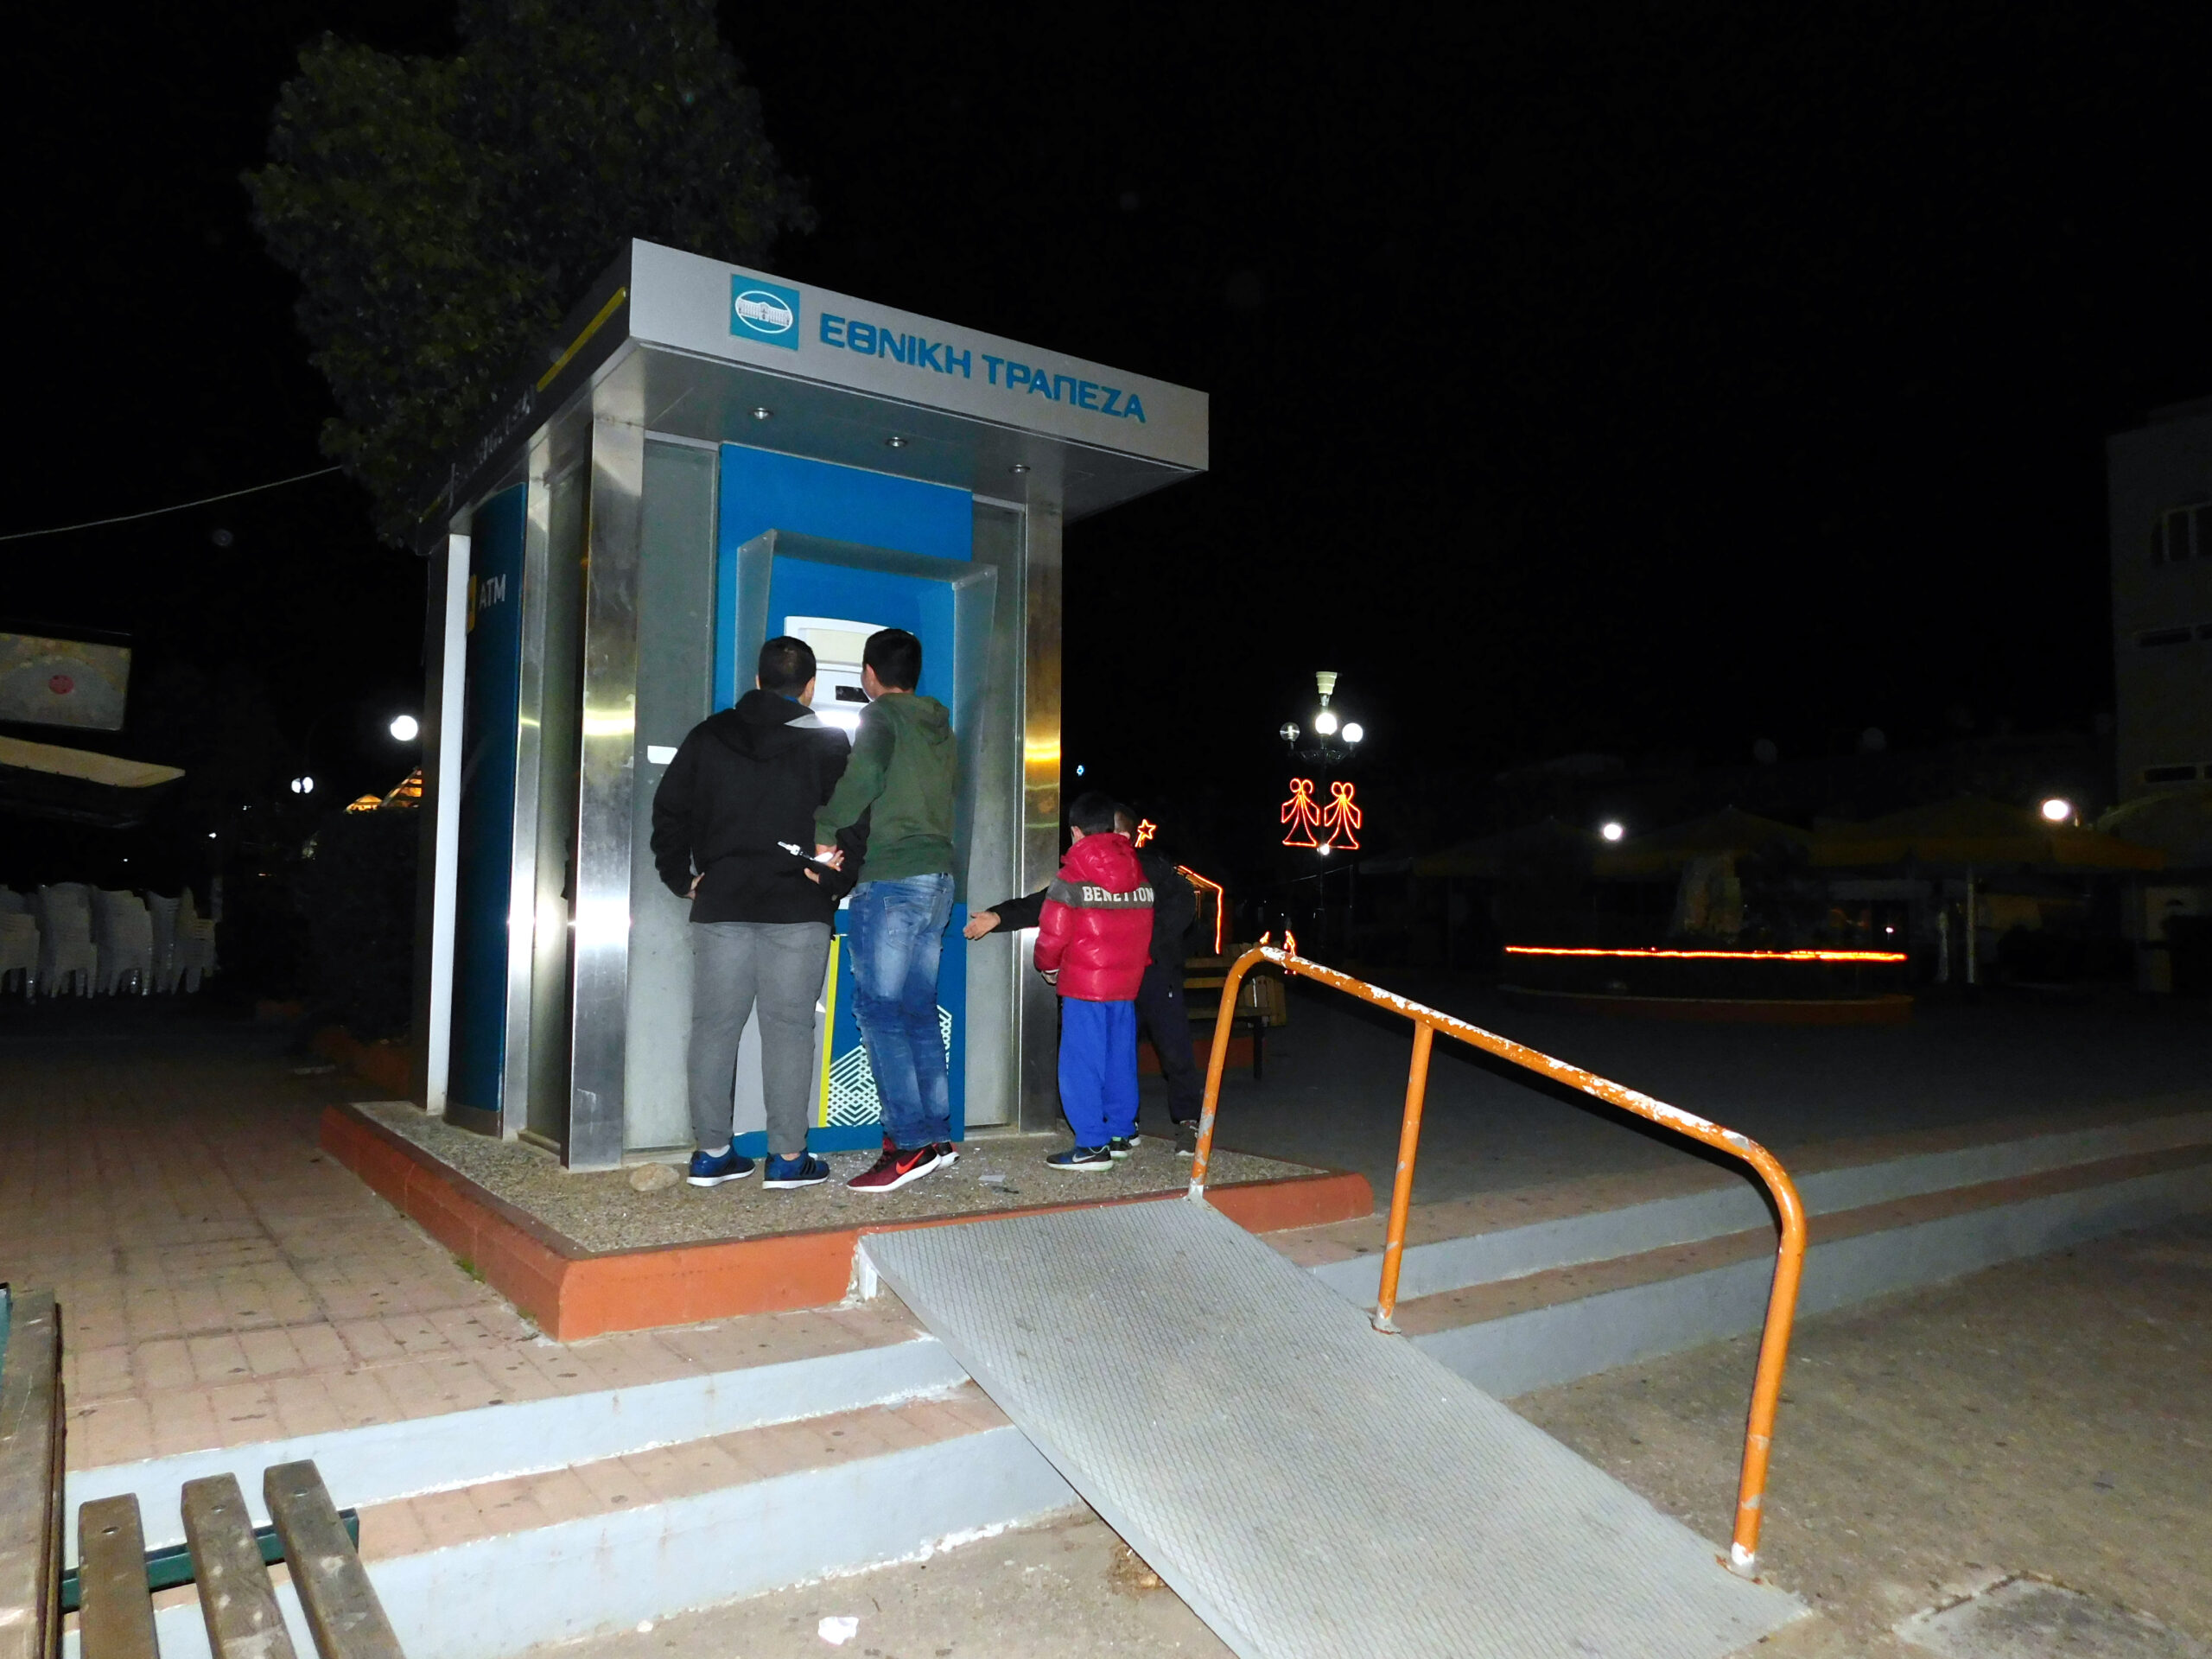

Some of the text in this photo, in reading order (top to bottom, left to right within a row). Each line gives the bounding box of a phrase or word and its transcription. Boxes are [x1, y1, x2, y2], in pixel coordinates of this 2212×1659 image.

[819, 312, 1147, 423] ΕΘΝΙΚΗ ΤΡΑΠΕΖΑ
[479, 573, 506, 611] ATM
